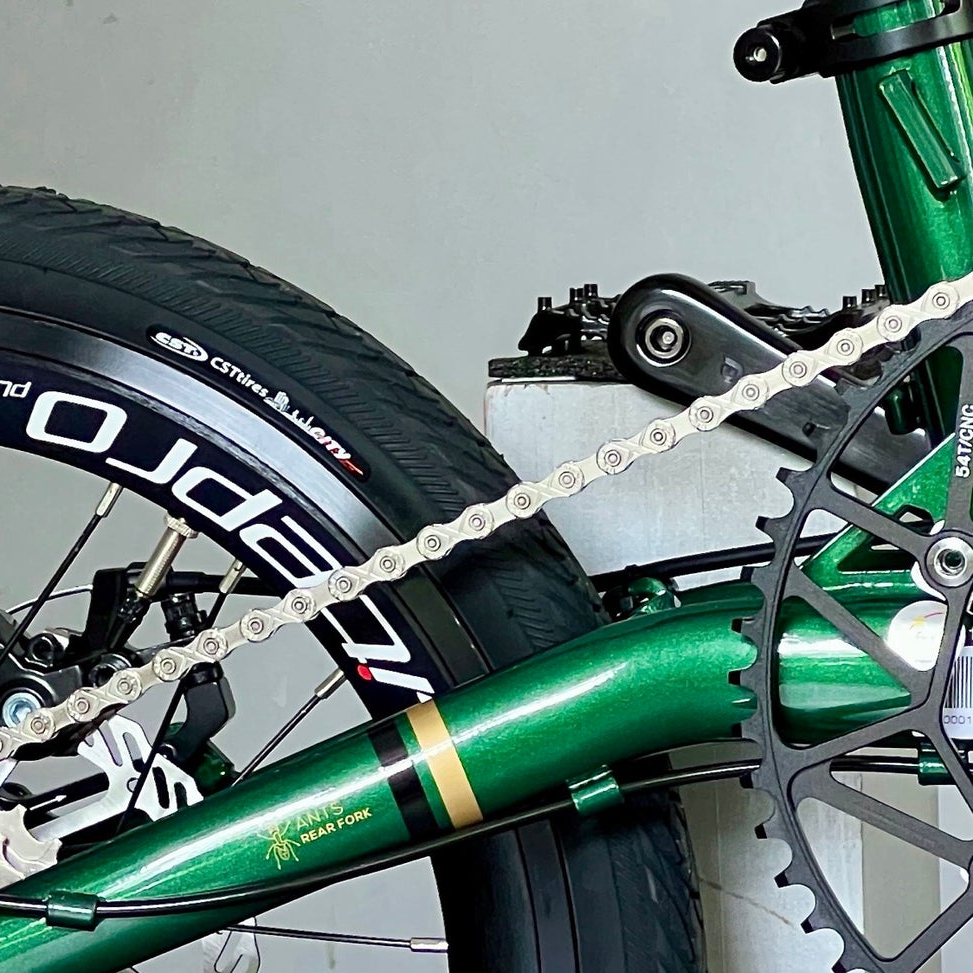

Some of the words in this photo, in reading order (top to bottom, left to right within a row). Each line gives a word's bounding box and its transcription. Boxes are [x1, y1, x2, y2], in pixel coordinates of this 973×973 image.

[210, 356, 270, 397] CSTtires
[296, 802, 344, 831] ANTS
[300, 823, 336, 844] REAR
[336, 807, 372, 830] FORK
